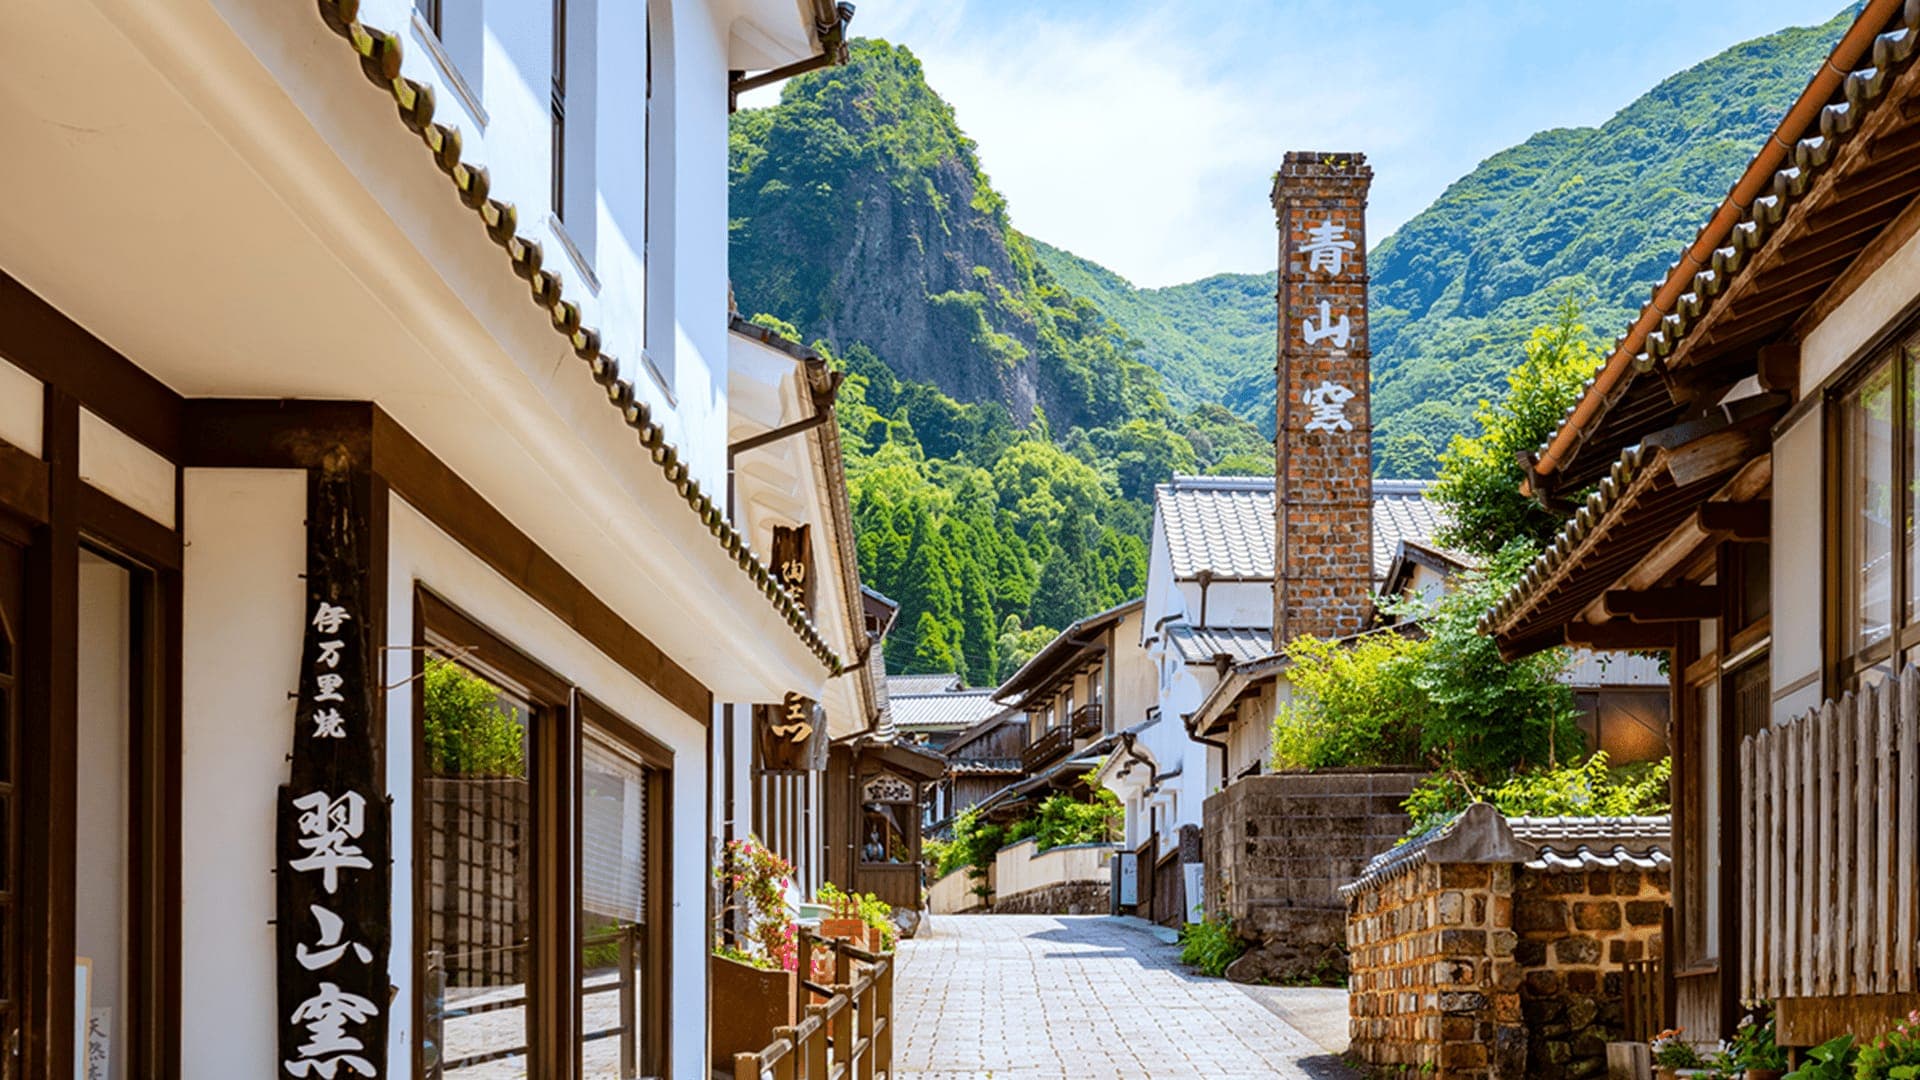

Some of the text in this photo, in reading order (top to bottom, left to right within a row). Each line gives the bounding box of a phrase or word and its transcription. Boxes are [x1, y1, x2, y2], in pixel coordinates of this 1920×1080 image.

[1298, 219, 1356, 435] 青山窯
[312, 601, 352, 739] 伊万里焼
[284, 790, 379, 1080] 翠山窯
